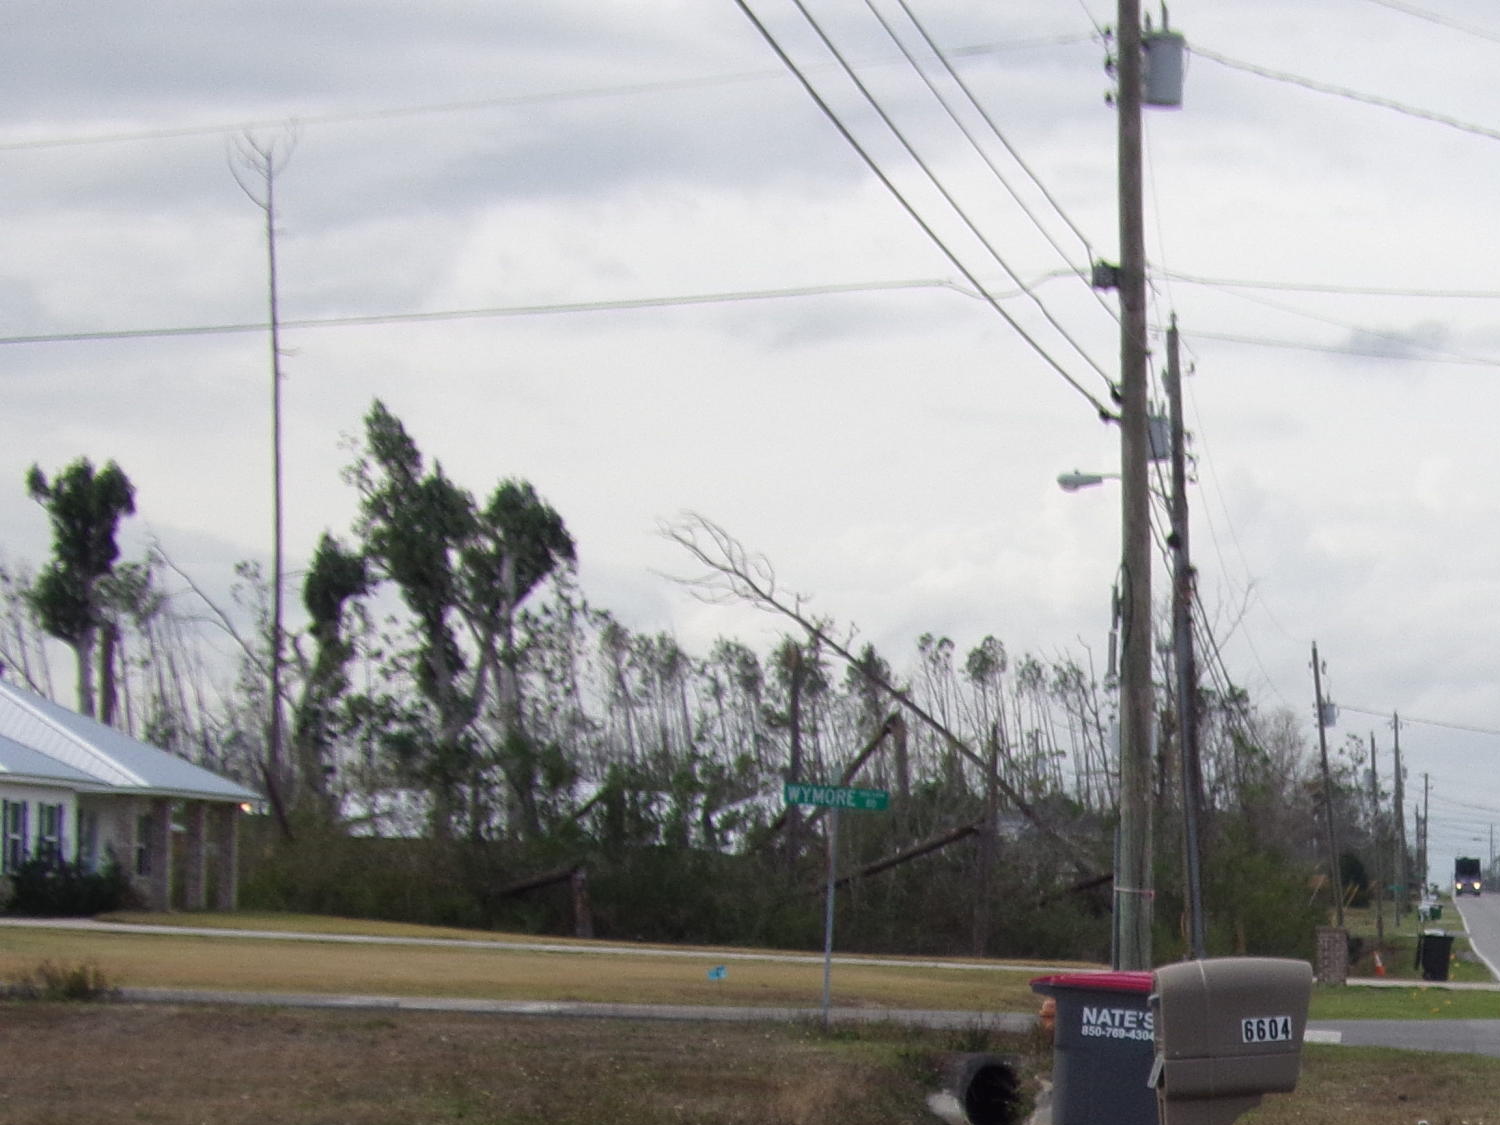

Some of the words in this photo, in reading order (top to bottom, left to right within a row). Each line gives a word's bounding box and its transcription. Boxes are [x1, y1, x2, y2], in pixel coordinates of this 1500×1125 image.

[787, 785, 856, 807] WYMORE
[1082, 1007, 1154, 1030] NATE'S
[1244, 1018, 1290, 1041] 6604
